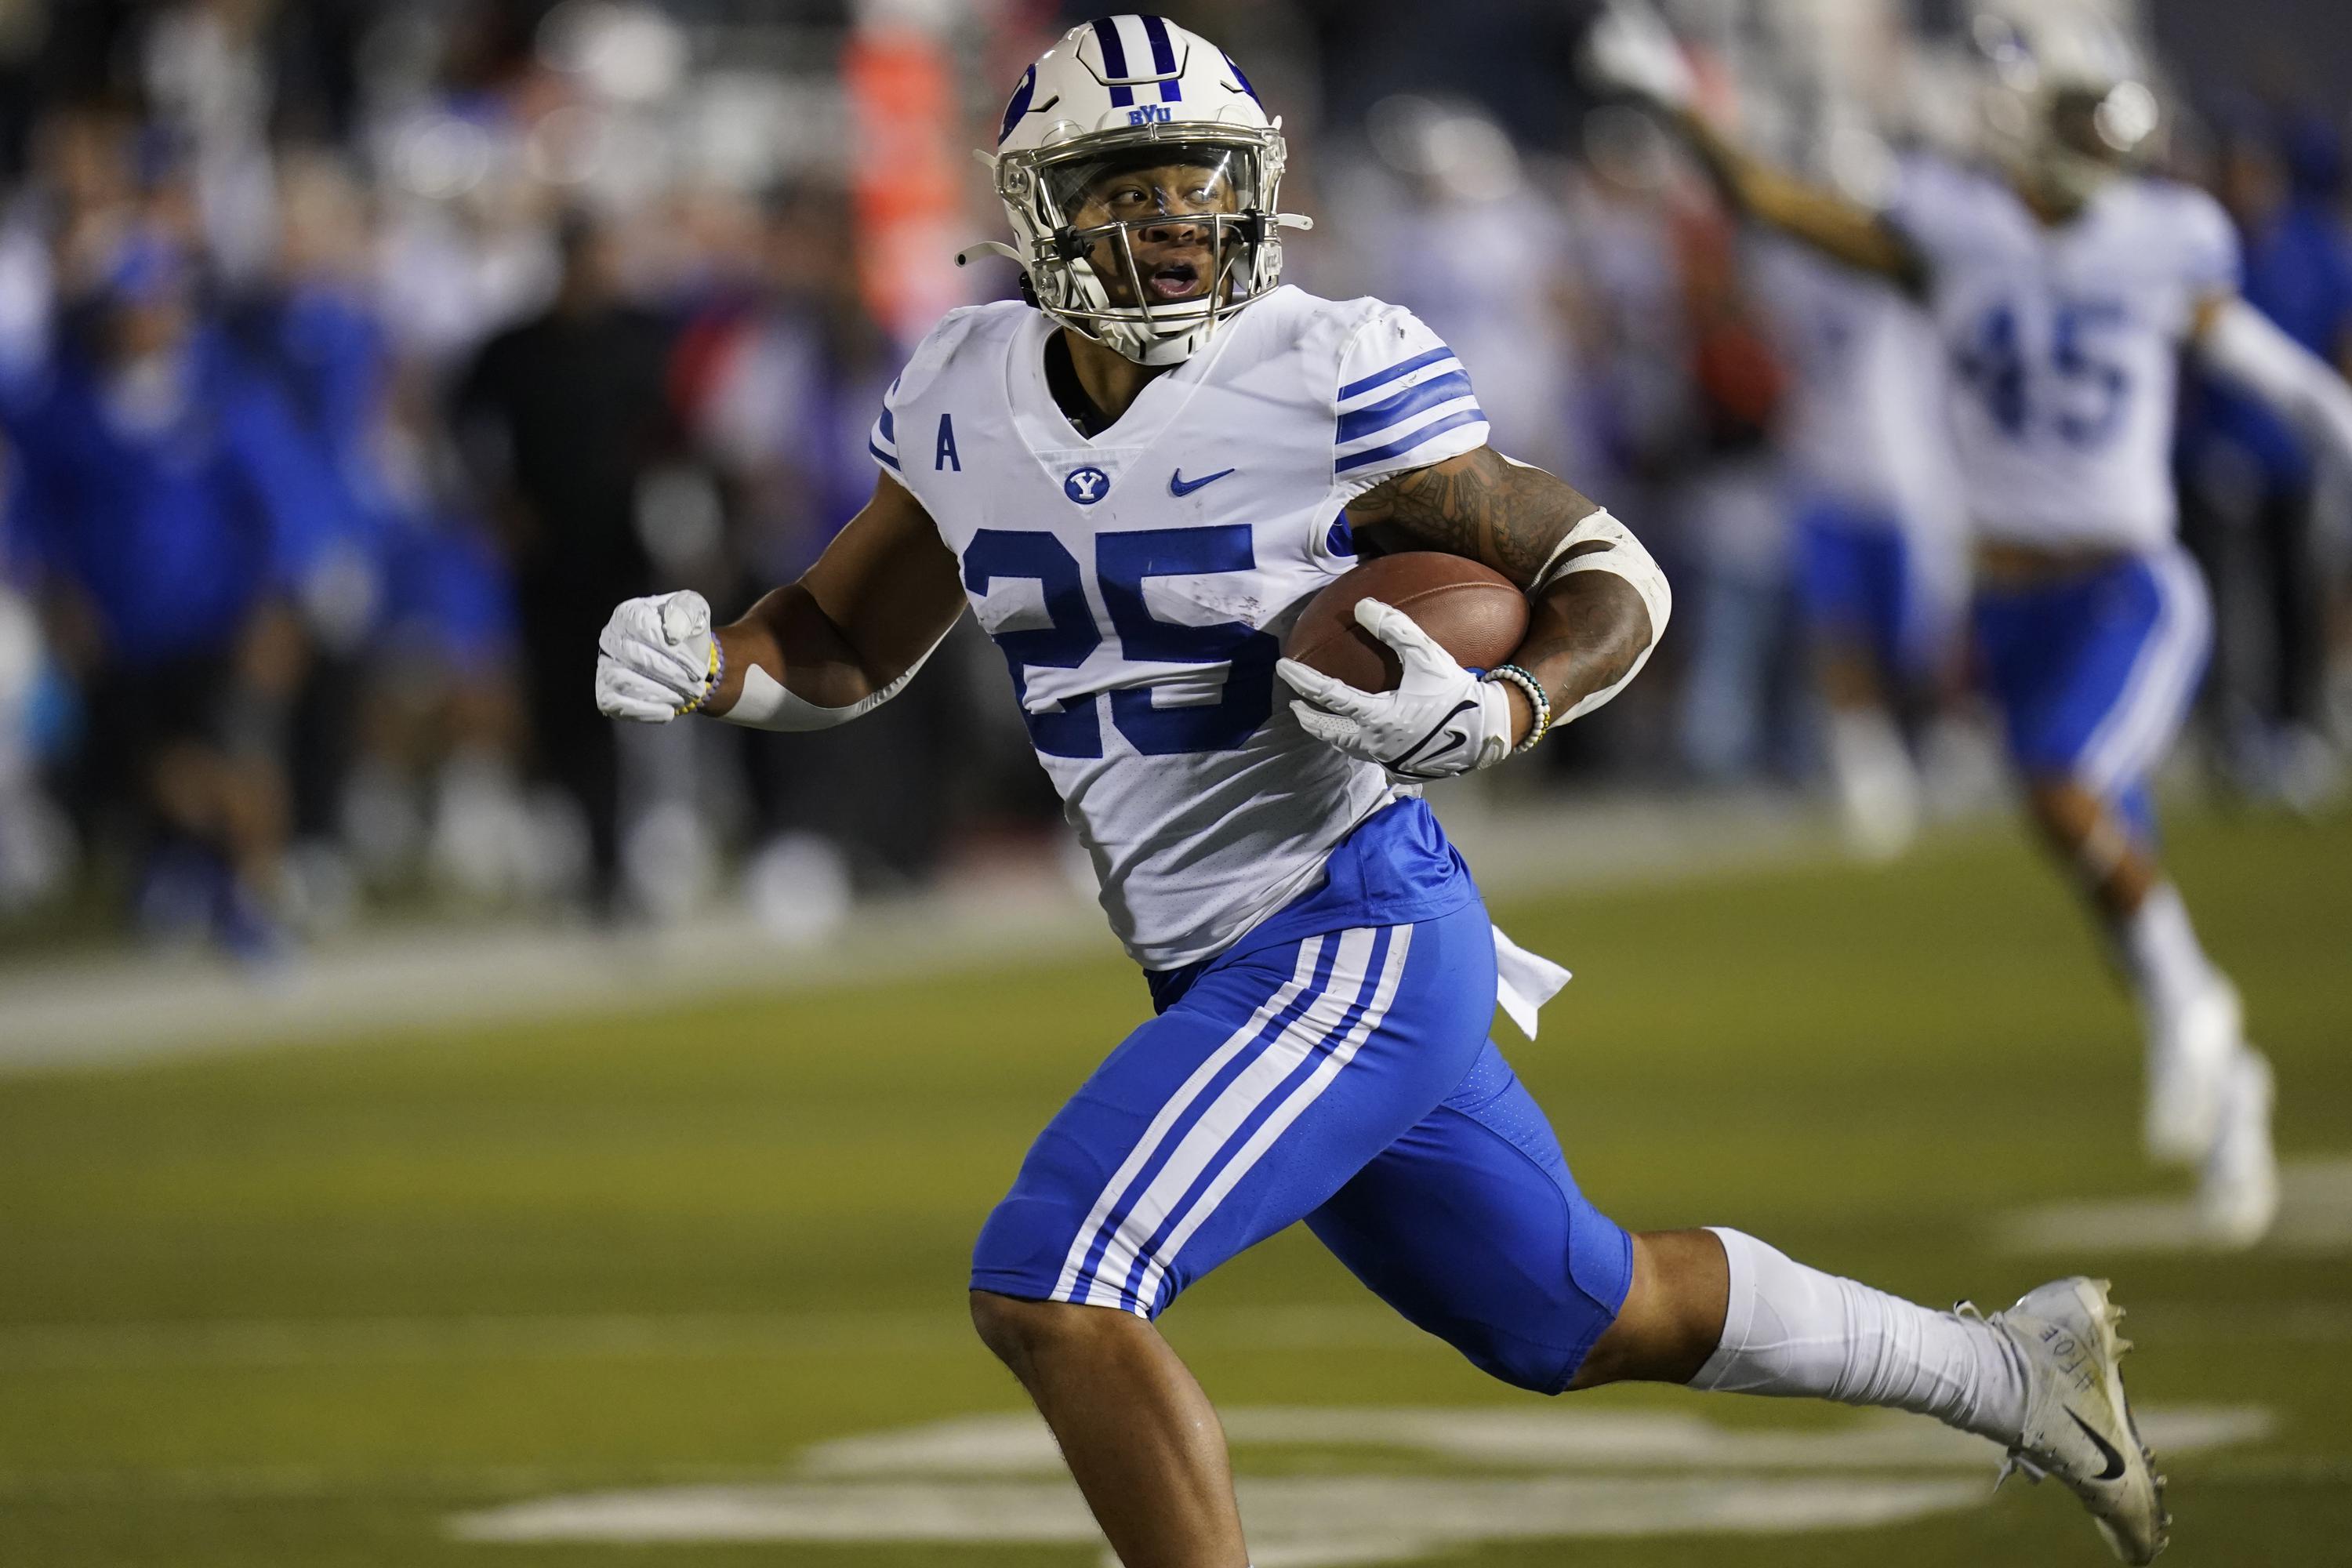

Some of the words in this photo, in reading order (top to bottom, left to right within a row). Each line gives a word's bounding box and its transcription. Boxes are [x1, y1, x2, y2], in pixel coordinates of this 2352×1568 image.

[1128, 103, 1171, 125] BYU
[935, 413, 961, 472] A
[1069, 472, 1102, 499] Y
[963, 524, 1279, 758] 25
